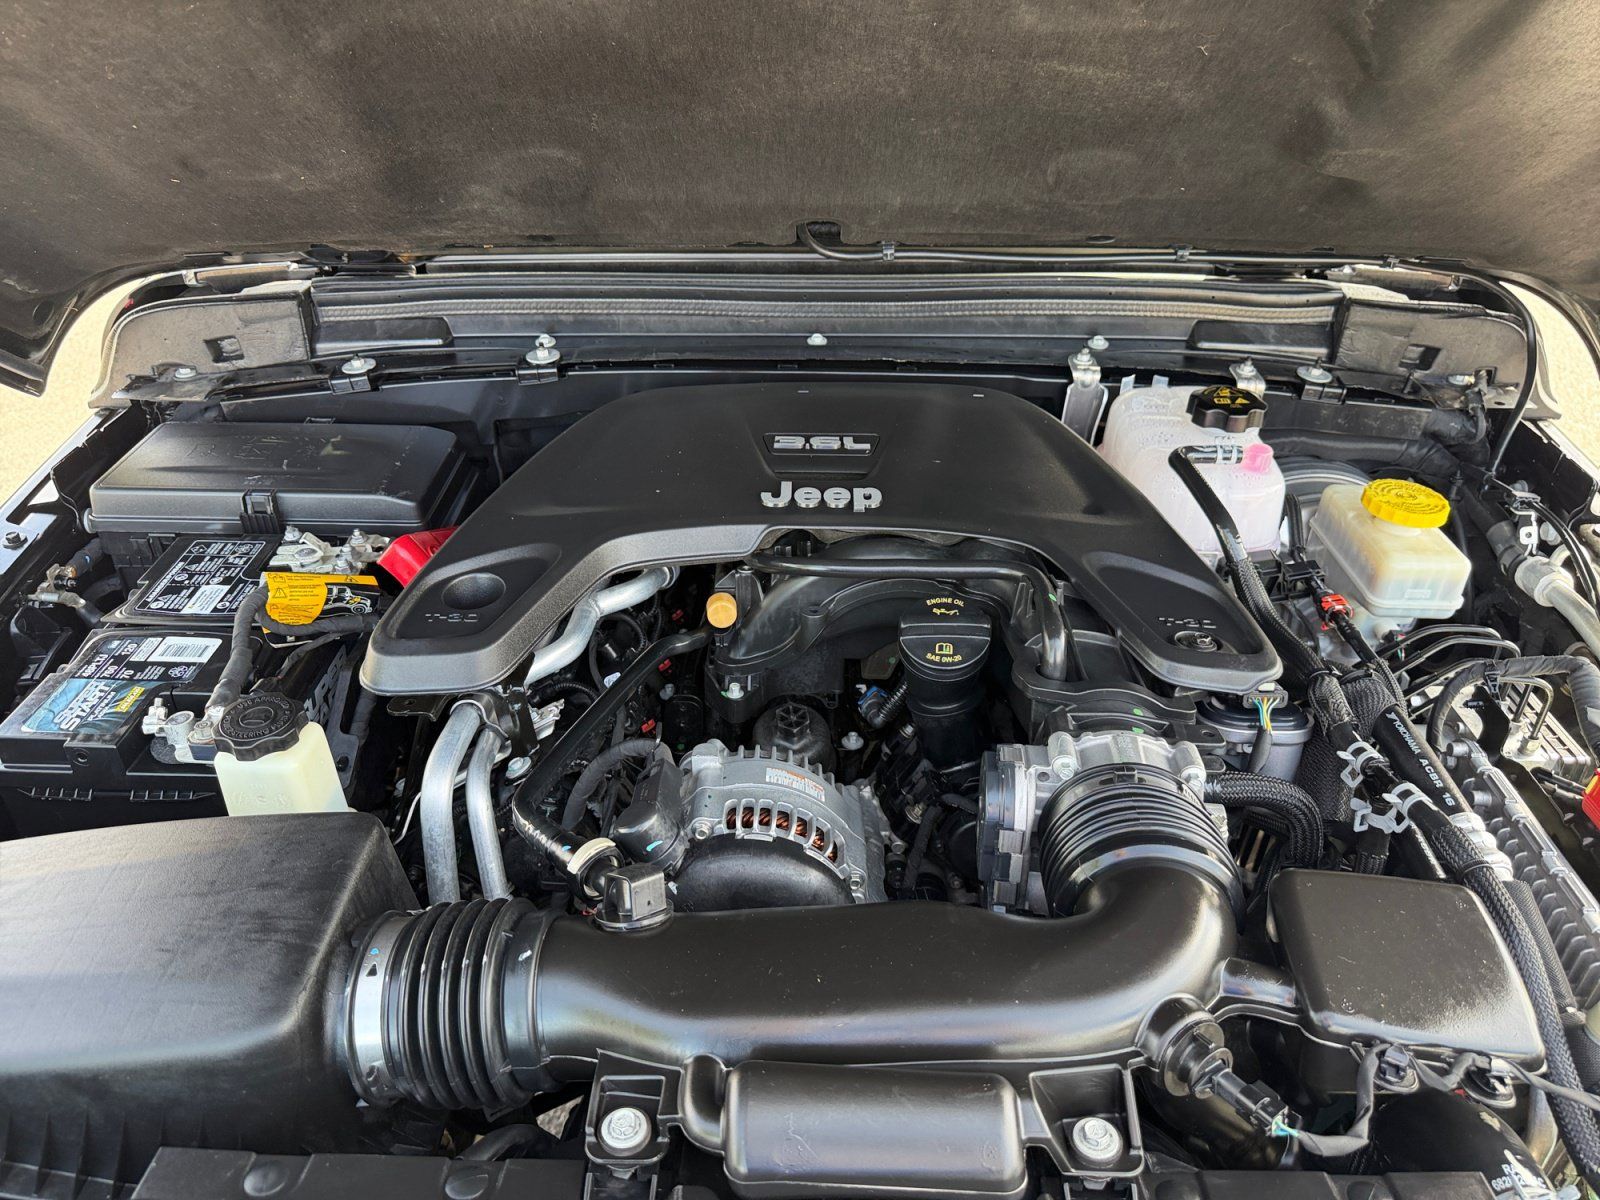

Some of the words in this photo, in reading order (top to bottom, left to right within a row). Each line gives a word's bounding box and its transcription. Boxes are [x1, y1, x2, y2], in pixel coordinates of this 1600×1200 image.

[773, 436, 871, 450] 3.6L
[760, 481, 883, 512] Jeep
[926, 597, 953, 606] ENGINE
[953, 599, 965, 607] OIL
[122, 643, 138, 656] 120
[926, 652, 940, 662] SAE
[941, 654, 962, 663] 0W-20
[121, 669, 135, 679] 70
[54, 680, 106, 724] SUPER
[60, 684, 111, 731] START
[1385, 711, 1421, 755] YOKOHAMA
[1419, 758, 1444, 788] ACBR
[1442, 791, 1456, 807] 16
